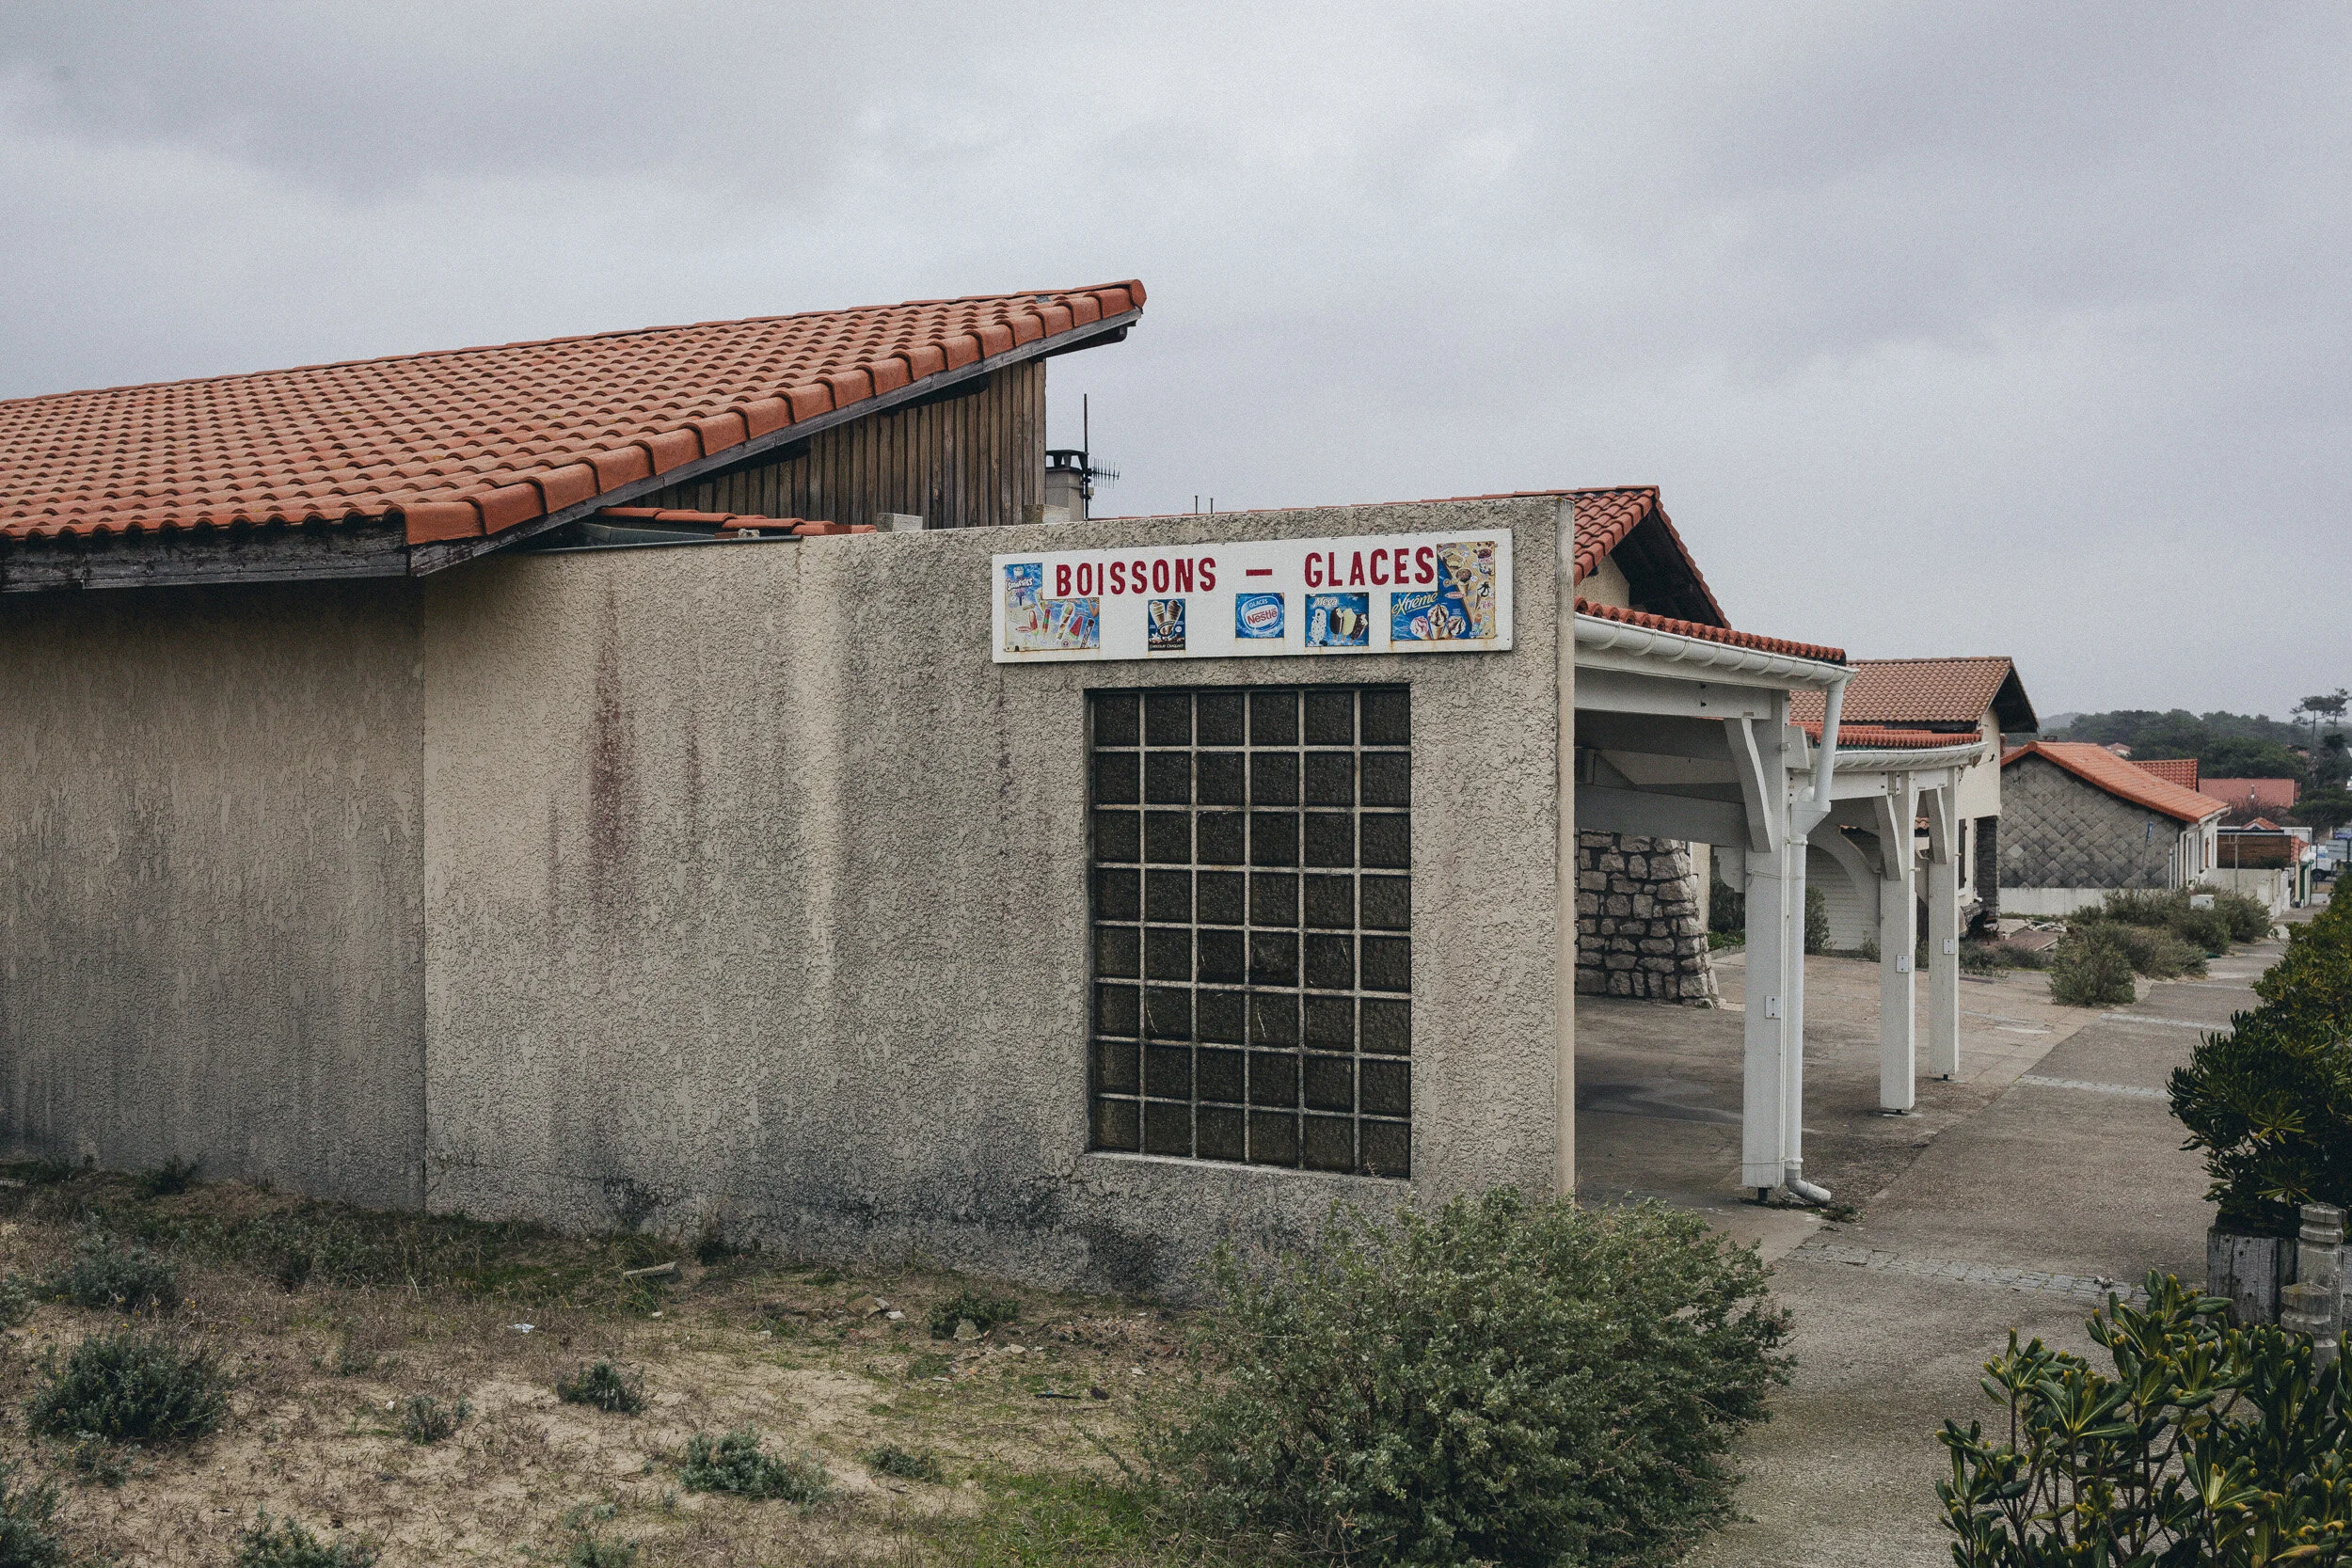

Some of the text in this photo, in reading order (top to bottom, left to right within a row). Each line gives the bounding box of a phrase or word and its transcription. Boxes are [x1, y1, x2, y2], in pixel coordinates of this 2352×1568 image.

[1056, 557, 1216, 597] BOISSONS
[1304, 546, 1435, 588] GLACES
[1248, 598, 1268, 608] GLACES
[1247, 608, 1278, 625] Nestlé
